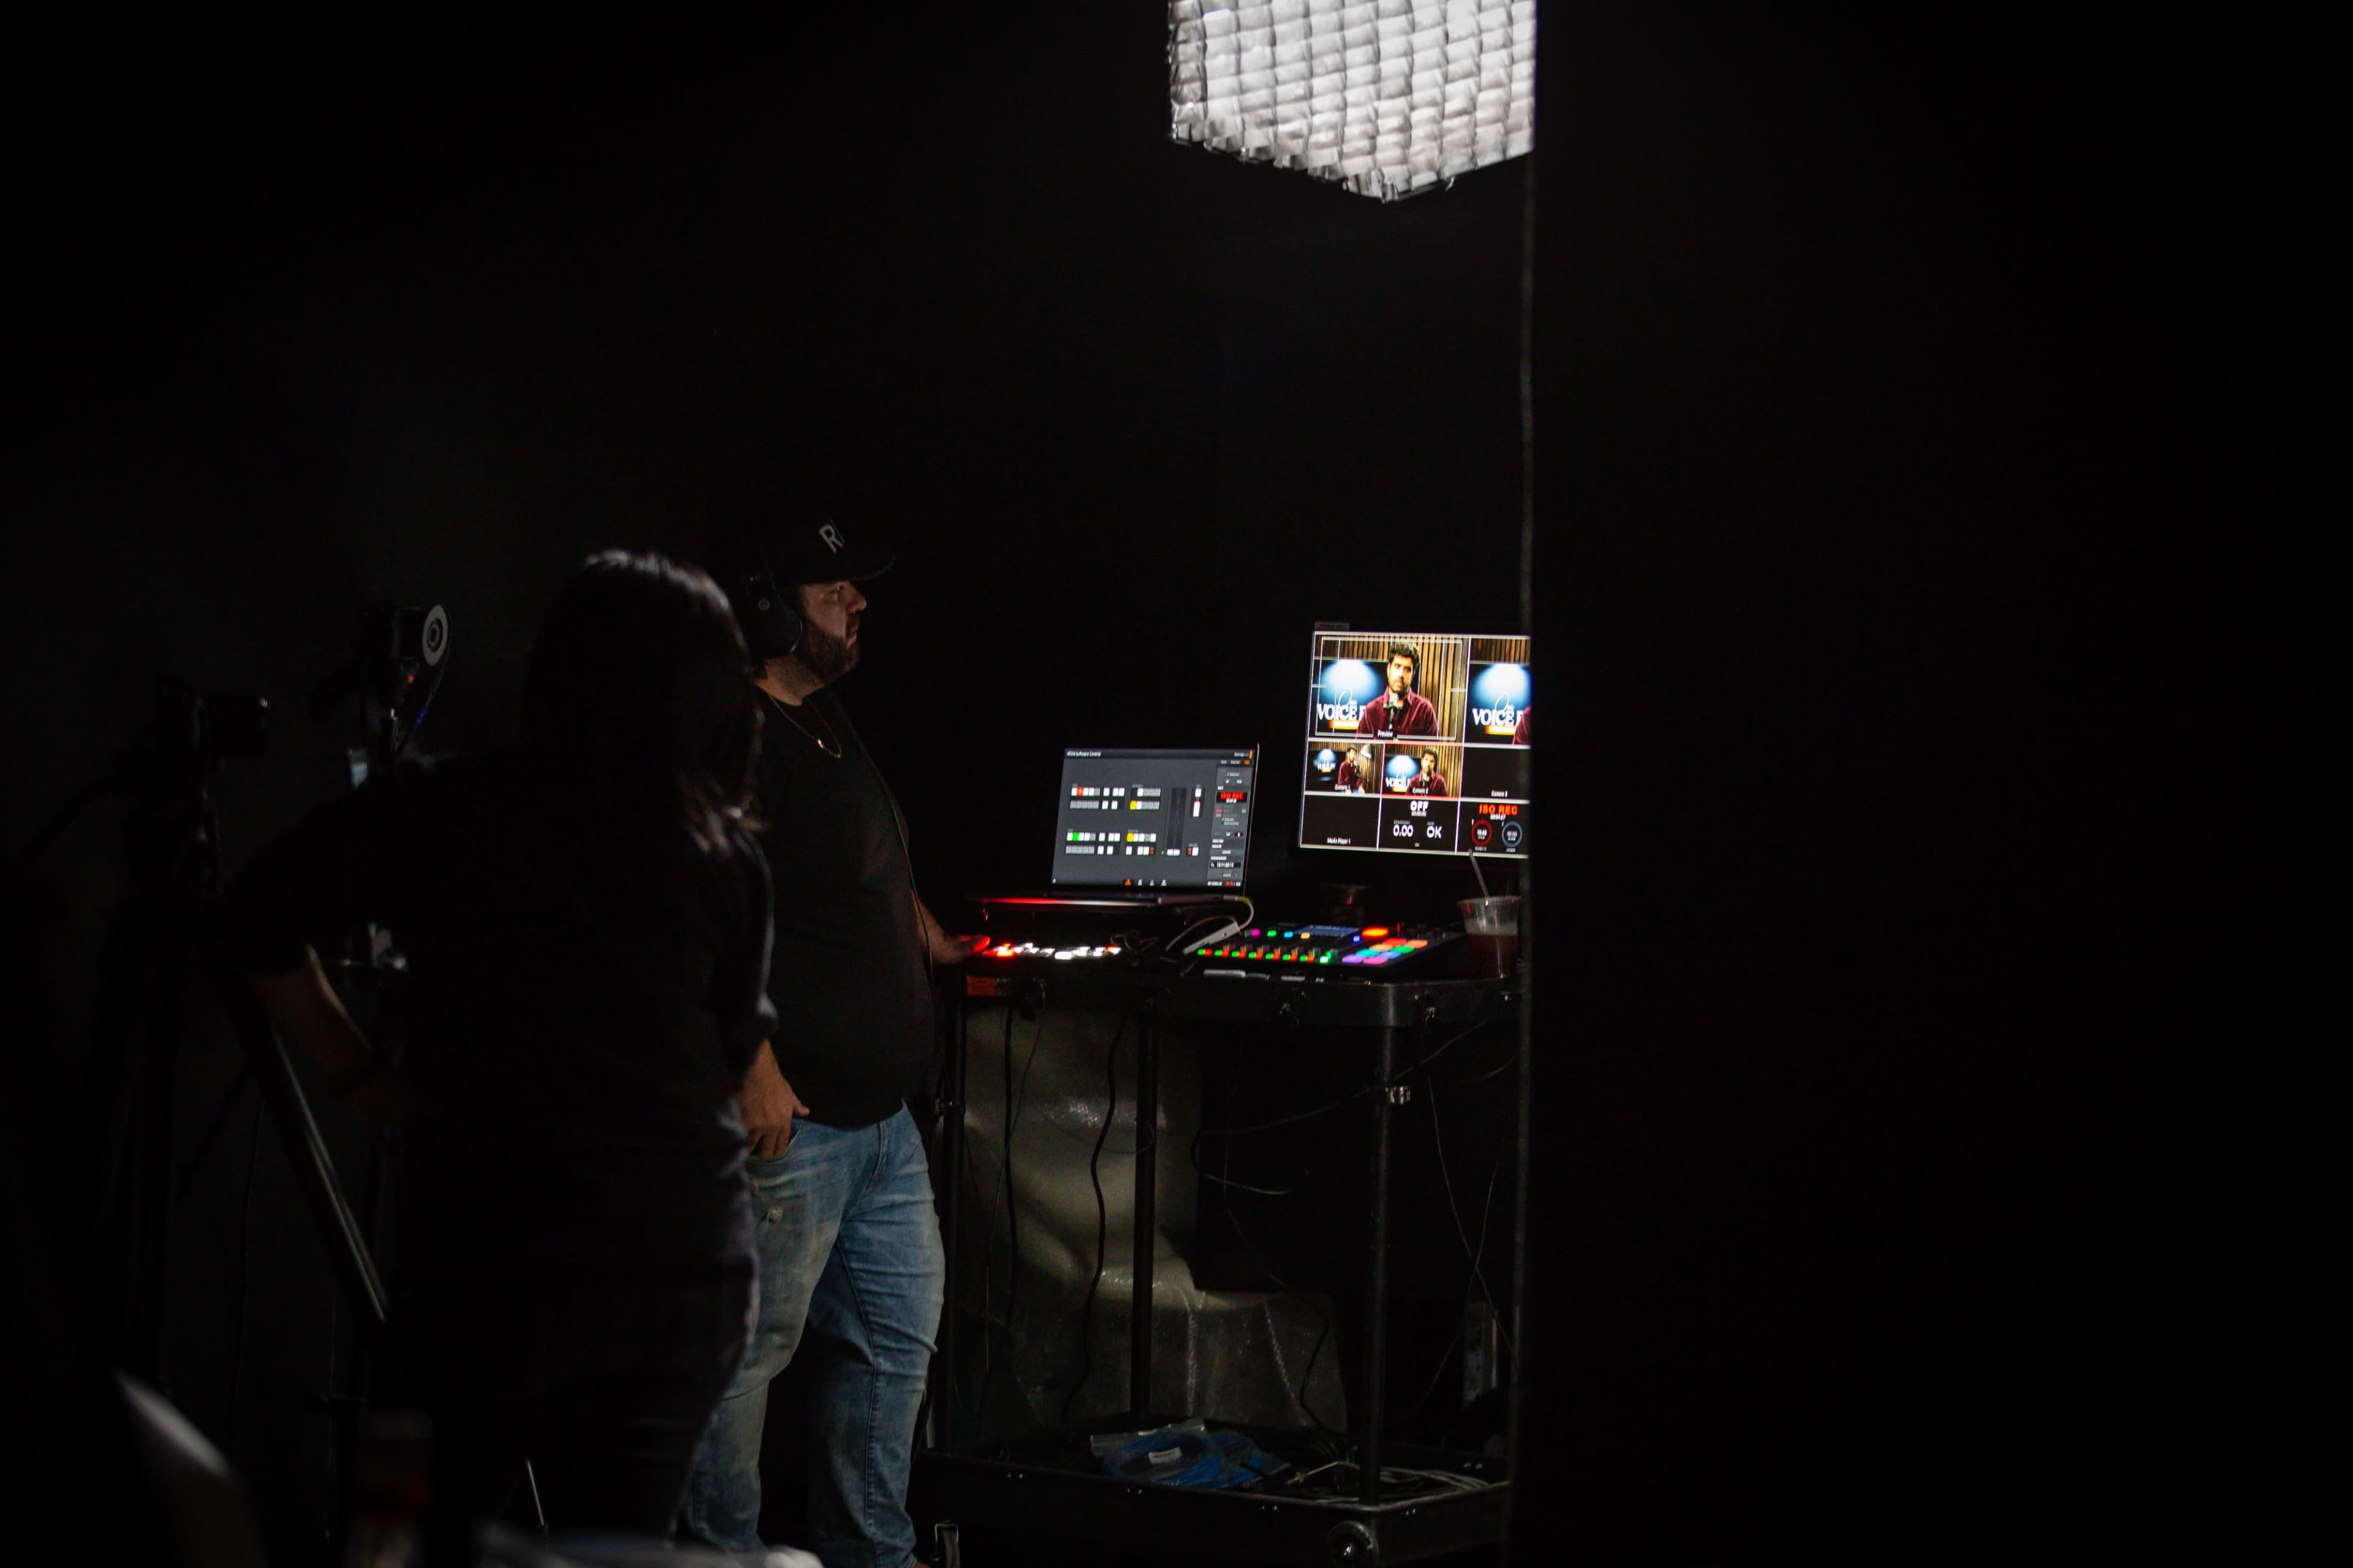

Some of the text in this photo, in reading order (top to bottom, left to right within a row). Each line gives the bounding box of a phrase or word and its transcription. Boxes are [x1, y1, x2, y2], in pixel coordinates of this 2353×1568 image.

[1317, 703, 1357, 720] VOICE
[1472, 708, 1514, 726] VOICE
[1410, 800, 1428, 811] OFF
[1479, 803, 1518, 815] ISO REC
[1393, 824, 1413, 837] 0.00
[1427, 825, 1442, 838] OK
